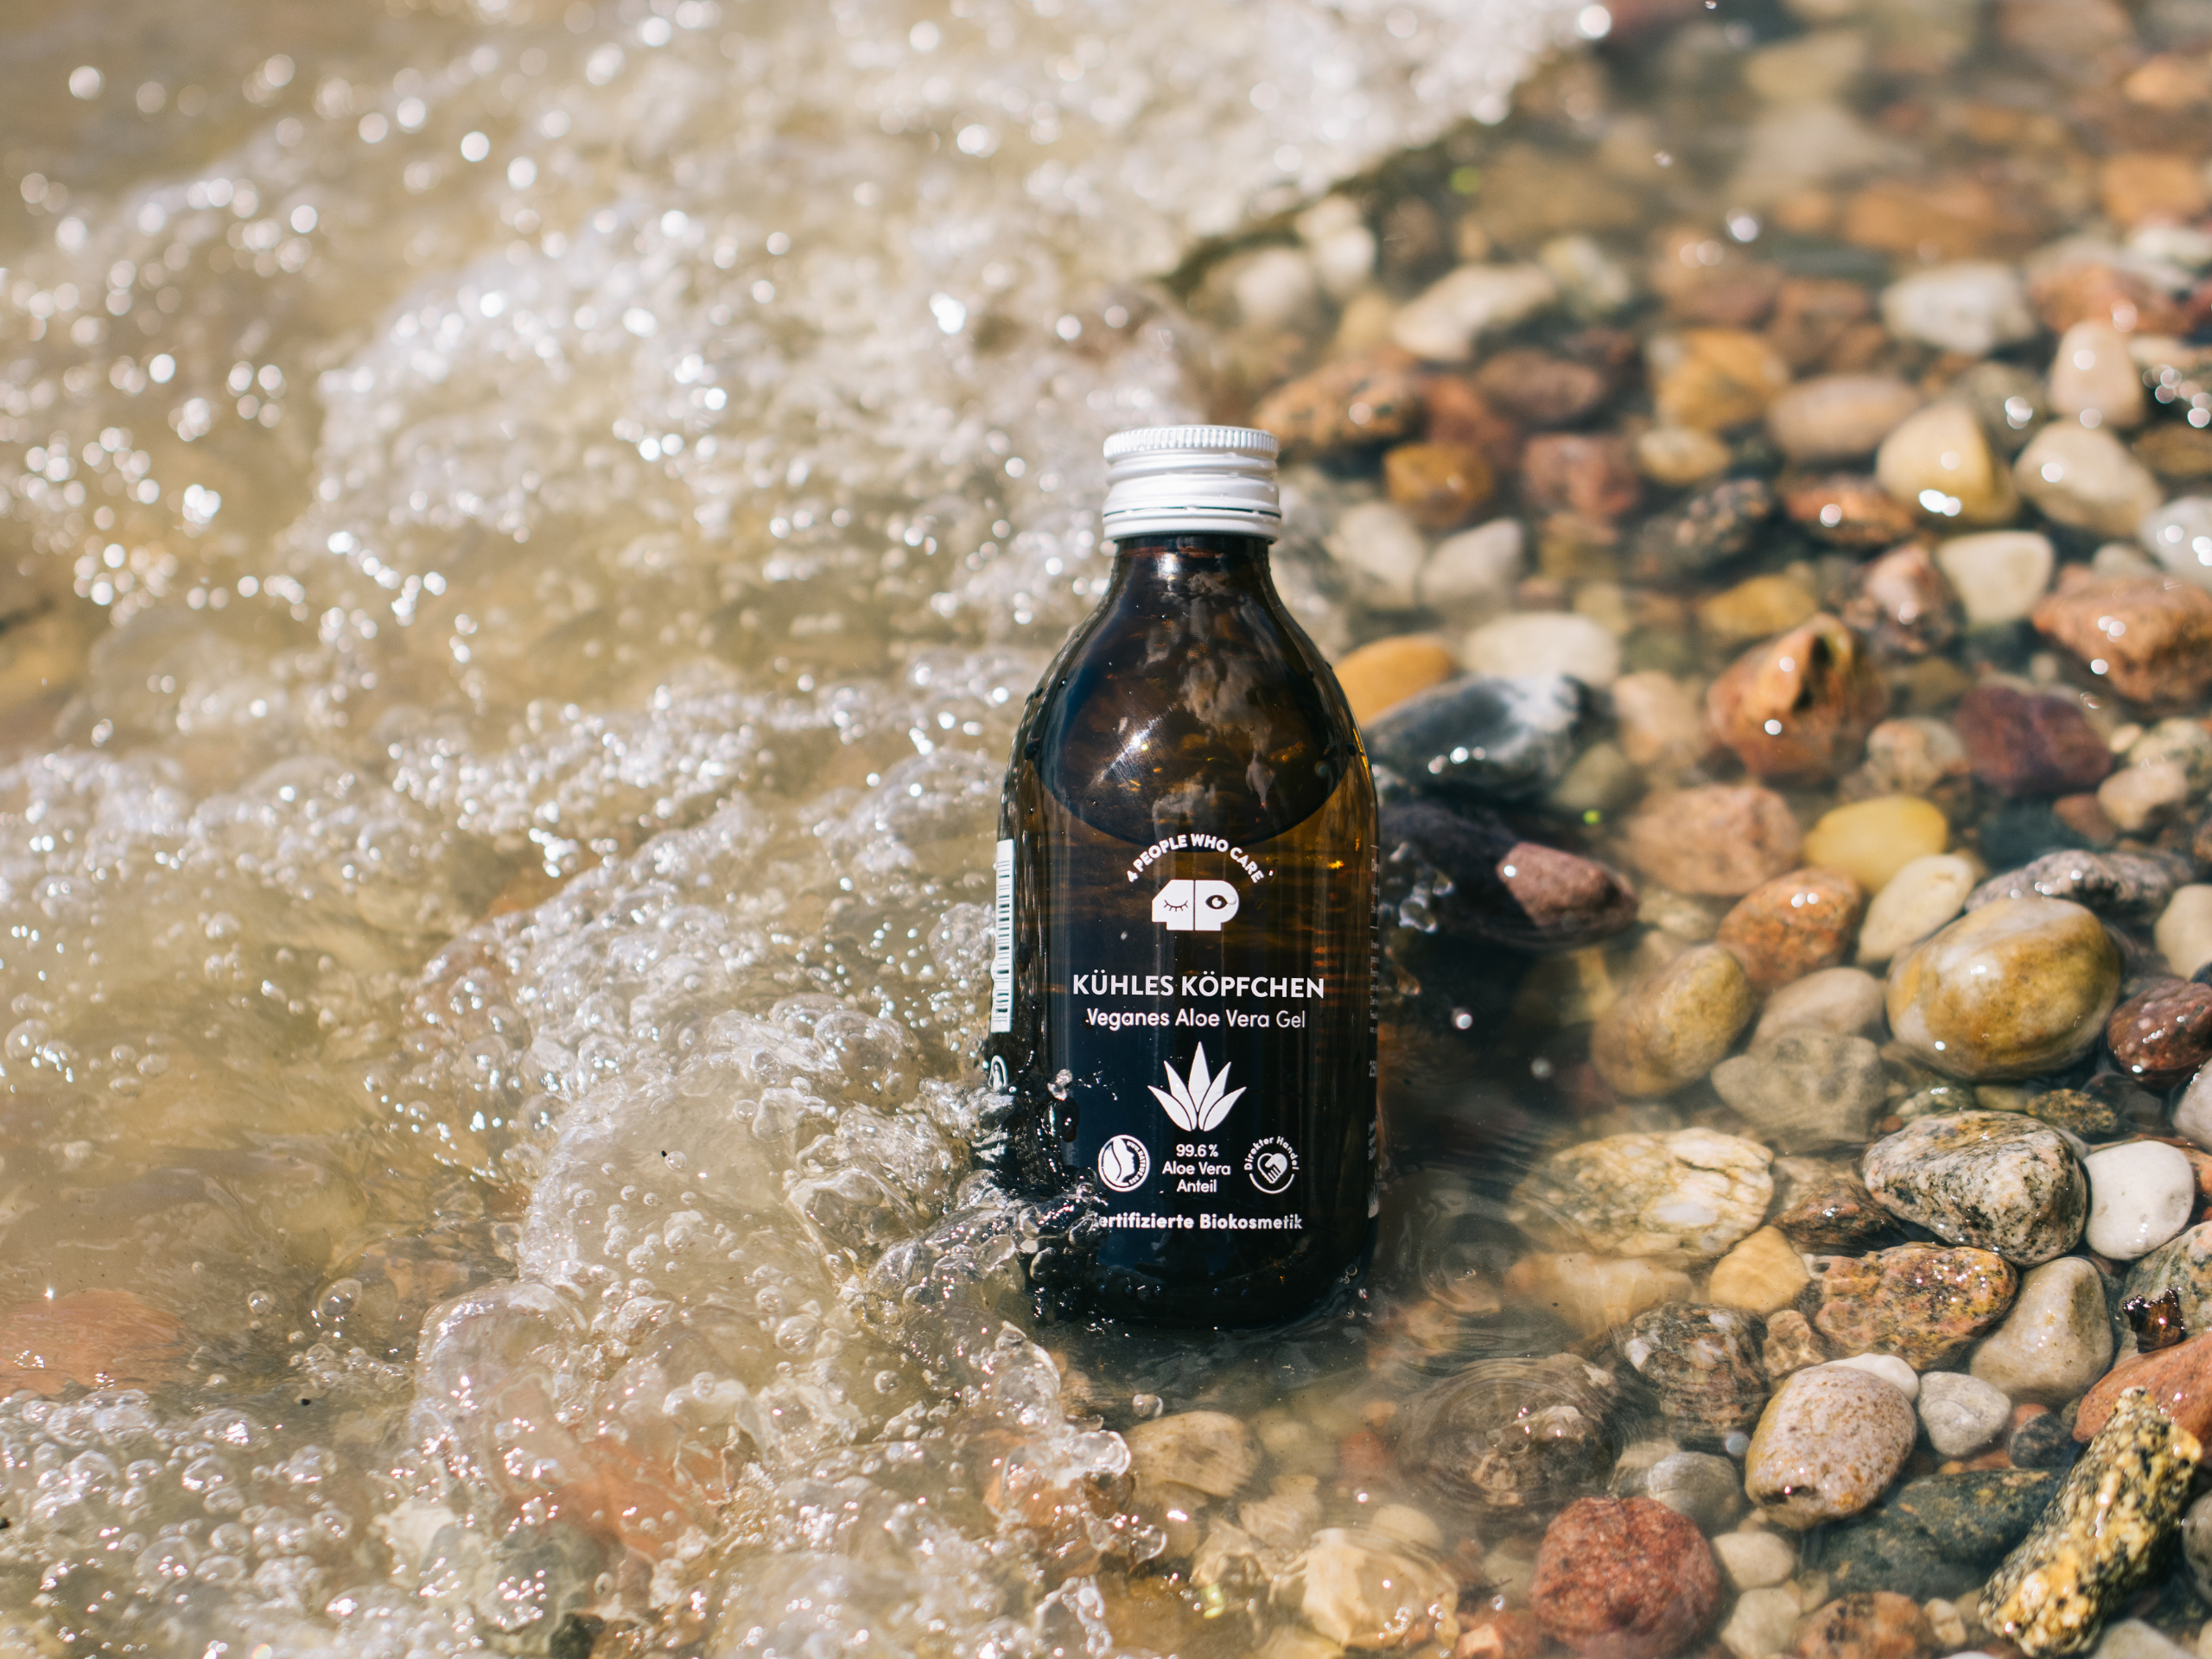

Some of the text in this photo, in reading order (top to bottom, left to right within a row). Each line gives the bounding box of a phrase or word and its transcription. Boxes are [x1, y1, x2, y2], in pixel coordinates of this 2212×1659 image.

[1127, 833, 1265, 883] 4 PEOPLE WHO CARE
[1073, 969, 1325, 999] KÜHLES KÖPFCHEN
[1087, 1007, 1306, 1032] Veganes Aloe Vera Gel
[1243, 1135, 1300, 1171] Direkter Handel
[1162, 1160, 1231, 1176] Aloe Vera
[1176, 1179, 1217, 1193] Anteil
[1098, 1211, 1303, 1230] ertifizierte Biokosmetik
